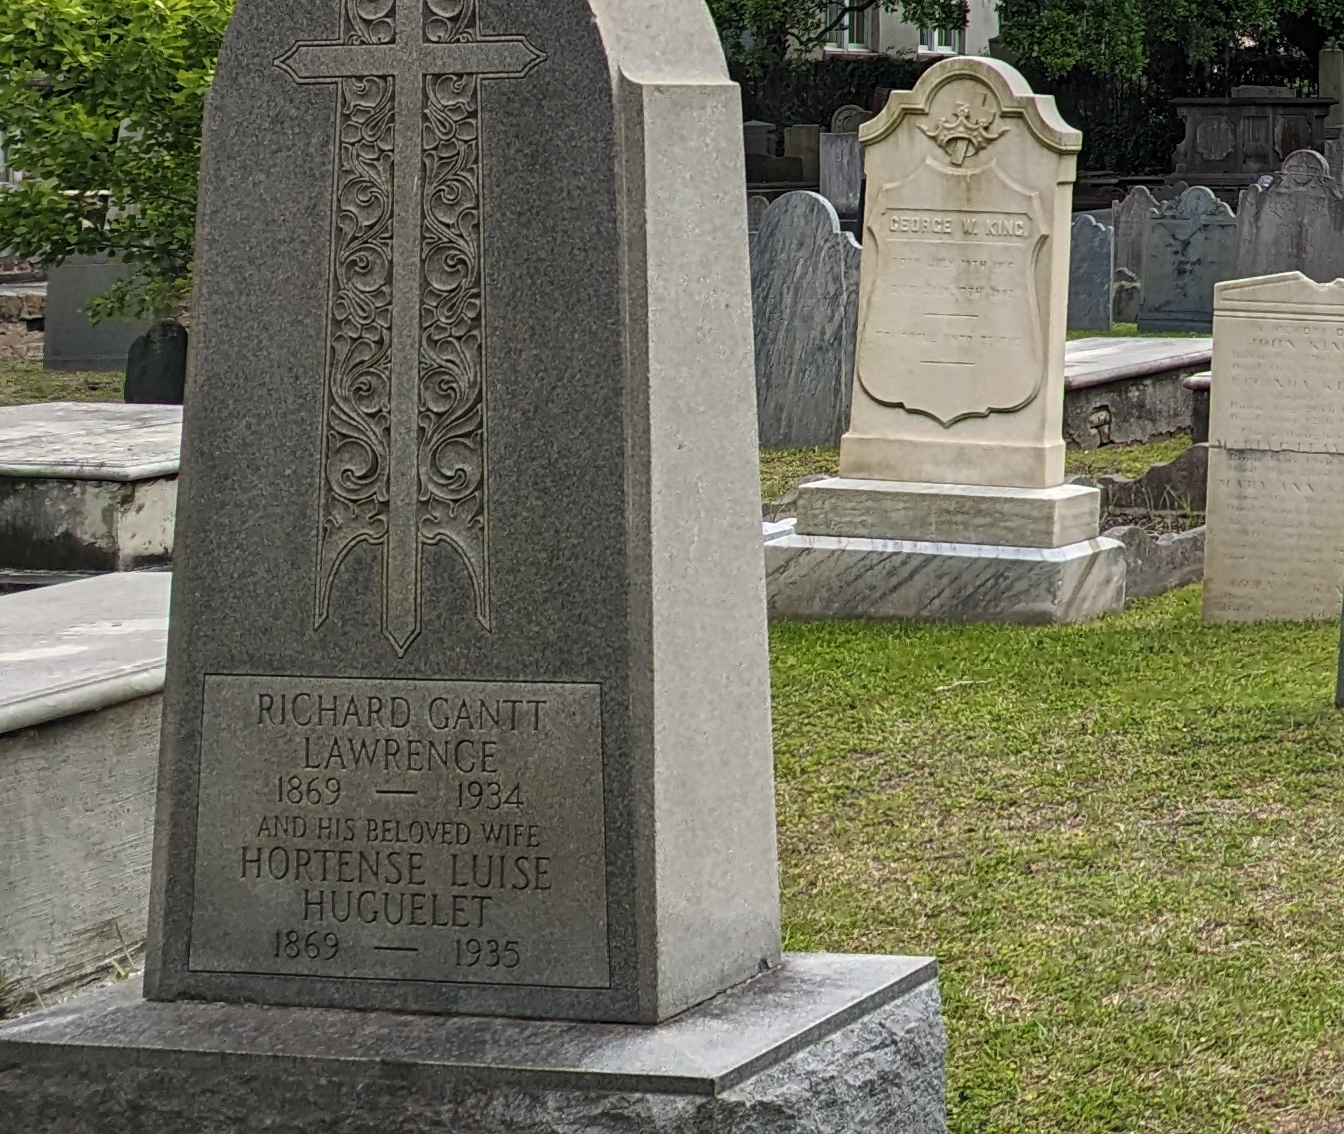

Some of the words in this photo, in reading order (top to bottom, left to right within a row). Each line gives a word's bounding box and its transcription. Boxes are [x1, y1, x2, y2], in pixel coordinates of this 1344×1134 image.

[889, 215, 952, 234] GEORGE
[961, 218, 979, 237] W.
[1248, 337, 1297, 349] JOHN
[256, 692, 412, 730] RICHARD
[428, 696, 548, 732] GANTT
[303, 736, 498, 774] LAWRENCE
[276, 776, 342, 806] 1869
[456, 781, 524, 810] 1934
[256, 815, 307, 839] AND
[317, 818, 355, 842] HIS
[366, 820, 471, 846] BELOVED
[481, 823, 541, 849] WIFE
[240, 846, 426, 887] HORTENSE
[449, 854, 552, 891] LUISE
[302, 889, 493, 929] HUGUELET
[273, 930, 340, 961] 1869
[454, 937, 520, 969] 1935
